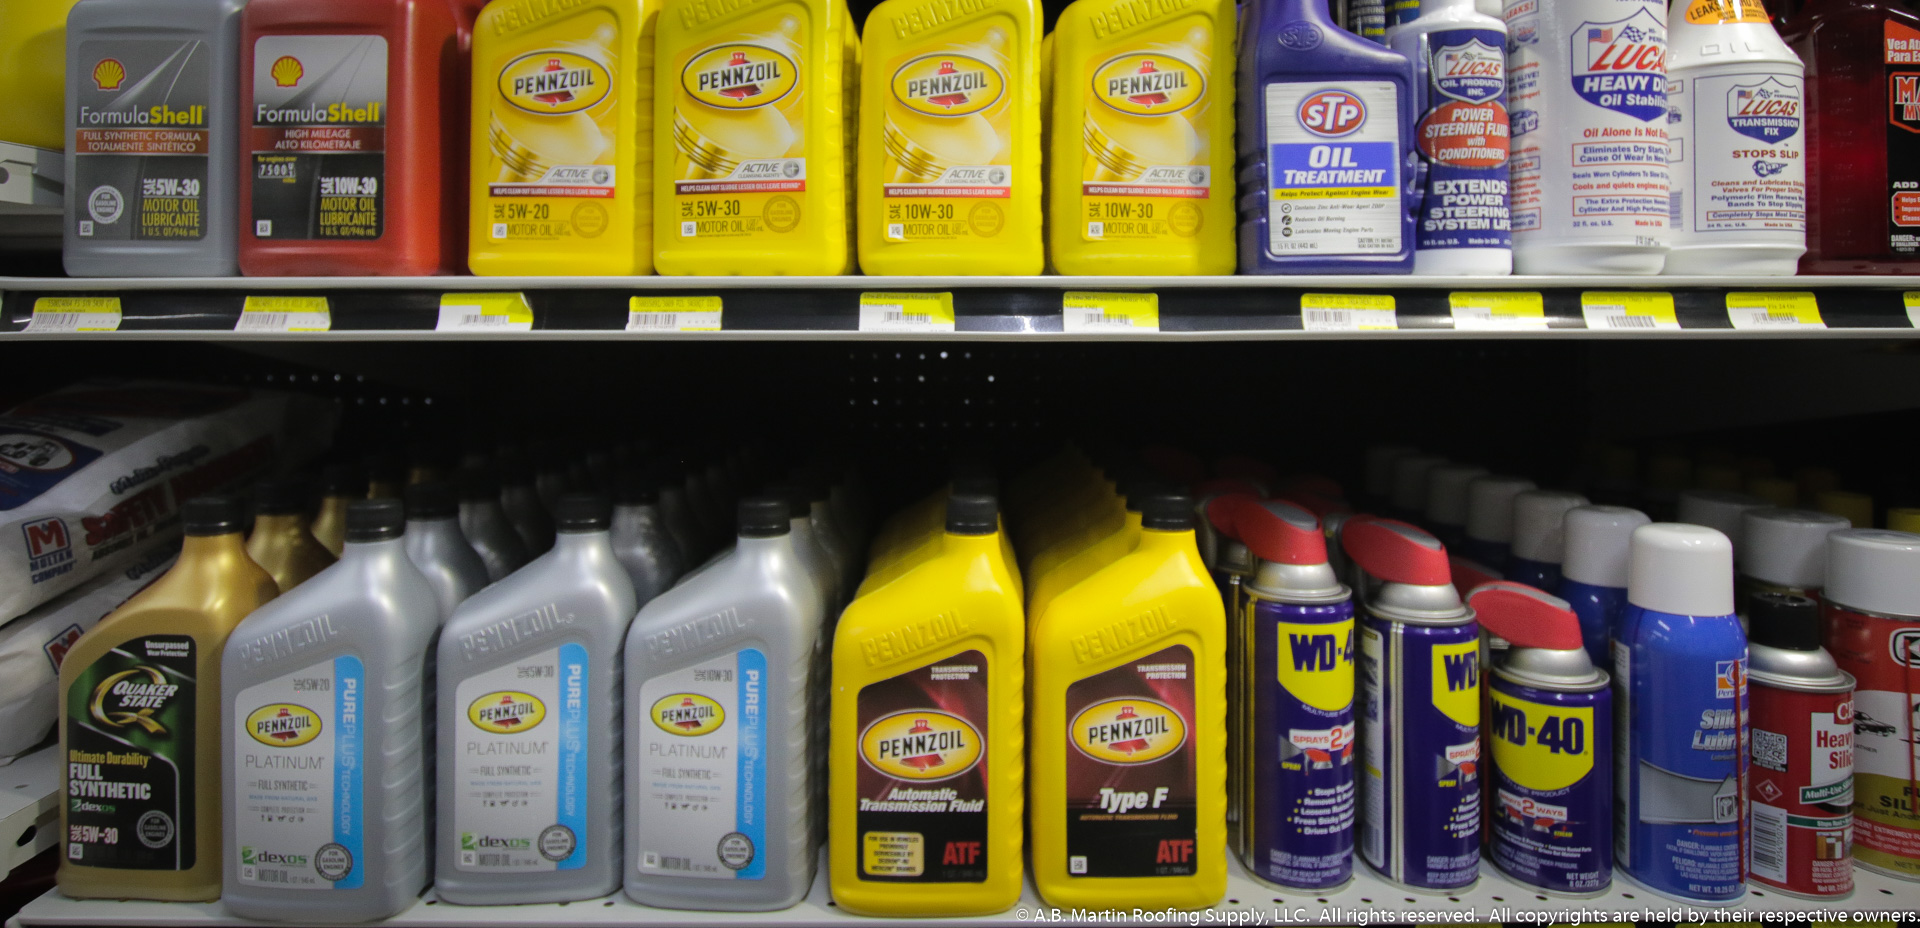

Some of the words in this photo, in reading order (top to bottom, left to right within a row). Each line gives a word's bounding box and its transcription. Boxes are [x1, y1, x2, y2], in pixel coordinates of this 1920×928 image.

[1887, 38, 1906, 50] Vea
[1887, 51, 1912, 62] Para
[1446, 61, 1502, 76] LUCAS
[514, 69, 595, 96] PENNZOIL
[698, 61, 782, 91] PENNZOIL
[1516, 71, 1540, 82] ALIVE!
[908, 71, 988, 98] PENNZOIL
[1109, 71, 1188, 97] PENNZOIL
[1441, 80, 1458, 88] OIL
[1460, 80, 1503, 88] PRODUCTS
[1518, 80, 1537, 90] NEW!
[1583, 76, 1650, 93] HEAVY
[1468, 88, 1486, 96] INC.
[1600, 94, 1622, 106] Oil
[81, 105, 203, 124] FormulaShell
[257, 102, 380, 122] FormulaShell
[1306, 96, 1359, 131] STP
[1738, 100, 1798, 116] LUCAS
[1452, 108, 1494, 122] POWER
[1732, 118, 1799, 128] TRANSMISSION
[83, 131, 102, 140] FULL
[105, 131, 152, 141] SYNTHETIC
[155, 132, 202, 142] FORMULA
[285, 130, 309, 138] HIGH
[311, 129, 352, 138] MILEAGE
[1425, 122, 1484, 138] STEERING
[1486, 123, 1508, 138] FLUID
[1584, 128, 1598, 138] Oil
[1602, 128, 1632, 137] Alone
[1634, 127, 1643, 136] Is
[1646, 128, 1658, 137] Not
[1764, 127, 1779, 136] FIX
[88, 142, 144, 151] TOTALMENTE
[147, 141, 196, 152] SINTÉTICO
[275, 140, 298, 150] ALTO
[300, 140, 362, 150] KILOMETRAJE
[1467, 136, 1486, 146] with
[1308, 145, 1358, 168] OIL
[1438, 148, 1505, 160] CONDITIONERS
[1584, 146, 1630, 154] Eliminates
[1634, 146, 1646, 154] Dry
[1732, 150, 1776, 158] STOPS
[1780, 150, 1799, 159] SLIP
[1580, 155, 1608, 163] Cause
[552, 168, 590, 178] ACTIVE
[742, 162, 780, 173] ACTIVE
[949, 169, 986, 179] ACTIVE
[1149, 169, 1186, 178] ACTIVE
[1284, 168, 1386, 186] TREATMENT
[1572, 172, 1592, 180] Seals
[1612, 170, 1641, 178] Cylinders
[143, 178, 156, 195] SAE
[156, 178, 200, 196] 5W-30
[335, 177, 378, 194] 10W-30
[1434, 179, 1508, 195] EXTENDS
[1572, 182, 1594, 190] Cools
[1613, 182, 1635, 190] quiets
[1765, 186, 1786, 194] Proper
[1892, 181, 1919, 189] ADD
[1351, 189, 1371, 197] Engine
[143, 198, 179, 212] MOTOR
[182, 198, 200, 212] OIL
[320, 198, 357, 212] MOTOR
[359, 198, 376, 212] OIL
[1443, 194, 1504, 206] POWER
[508, 203, 550, 220] 5W-20
[682, 201, 694, 217] SAE
[697, 200, 740, 216] 5W-30
[890, 204, 901, 219] SAE
[905, 204, 954, 220] 10W-30
[1089, 202, 1100, 218] SAE
[1105, 202, 1154, 218] 10W-30
[1430, 206, 1510, 219] STEERING
[142, 213, 200, 227] LUBRICANTE
[320, 212, 376, 226] LUBRICANTE
[1424, 218, 1490, 231] SYSTEM
[1492, 218, 1512, 231] LIFE
[507, 223, 536, 236] MOTOR
[539, 224, 553, 236] OIL
[696, 220, 728, 233] MOTOR
[731, 220, 745, 232] OIL
[904, 224, 934, 236] MOTOR
[937, 224, 951, 236] OIL
[1104, 222, 1134, 235] MOTOR
[1138, 222, 1151, 234] OIL
[27, 520, 66, 556] M
[32, 562, 73, 584] COMPANY
[145, 641, 190, 650] Unsurpassed
[930, 665, 978, 674] TRANSMISSION
[1136, 664, 1187, 672] TRANSMISSION
[930, 672, 970, 680] PROTECTION
[1146, 672, 1187, 680] PROTECTION
[112, 680, 178, 697] QUAKER
[118, 696, 167, 708] STATE
[479, 702, 536, 722] PENNZOIL
[661, 706, 715, 723] PENNZOIL
[256, 715, 312, 734] PENNZOIL
[1088, 716, 1170, 745] PENNZOIL
[1492, 696, 1585, 756] WD-40
[880, 730, 965, 760] PENNZOIL
[1293, 735, 1330, 744] SPRAYS
[1330, 727, 1344, 750] 2
[466, 741, 547, 756] PLATINUM
[648, 743, 725, 760] PLATINUM
[70, 750, 106, 764] Ultimate
[106, 752, 149, 768] Durability
[245, 754, 322, 770] PLATINUM
[70, 763, 103, 780] FULL
[480, 765, 495, 777] FULL
[496, 765, 532, 776] SYNTHETIC
[1281, 762, 1302, 772] SPRAY
[69, 780, 152, 800] SYNTHETIC
[258, 779, 273, 791] FULL
[274, 780, 309, 792] SYNTHETIC
[888, 788, 958, 801] Automatic
[1100, 787, 1149, 814] Type
[1152, 786, 1170, 809] F
[81, 802, 116, 812] dexos
[860, 798, 948, 812] Transmission
[948, 799, 985, 812] Fluid
[1522, 798, 1535, 816] 2
[1536, 806, 1566, 817] WAYS.
[1294, 816, 1318, 826] Frees
[82, 826, 119, 844] 5W-30
[1304, 826, 1328, 836] Drives
[1554, 830, 1574, 838] STREAM
[478, 835, 530, 848] dexos
[258, 850, 308, 865] dexos
[942, 841, 982, 866] ATF
[1156, 840, 1194, 864] ATF
[1566, 872, 1579, 880] NET
[1580, 871, 1600, 880] WEIGHT
[1688, 884, 1700, 892] NET
[1702, 885, 1712, 894] WT.
